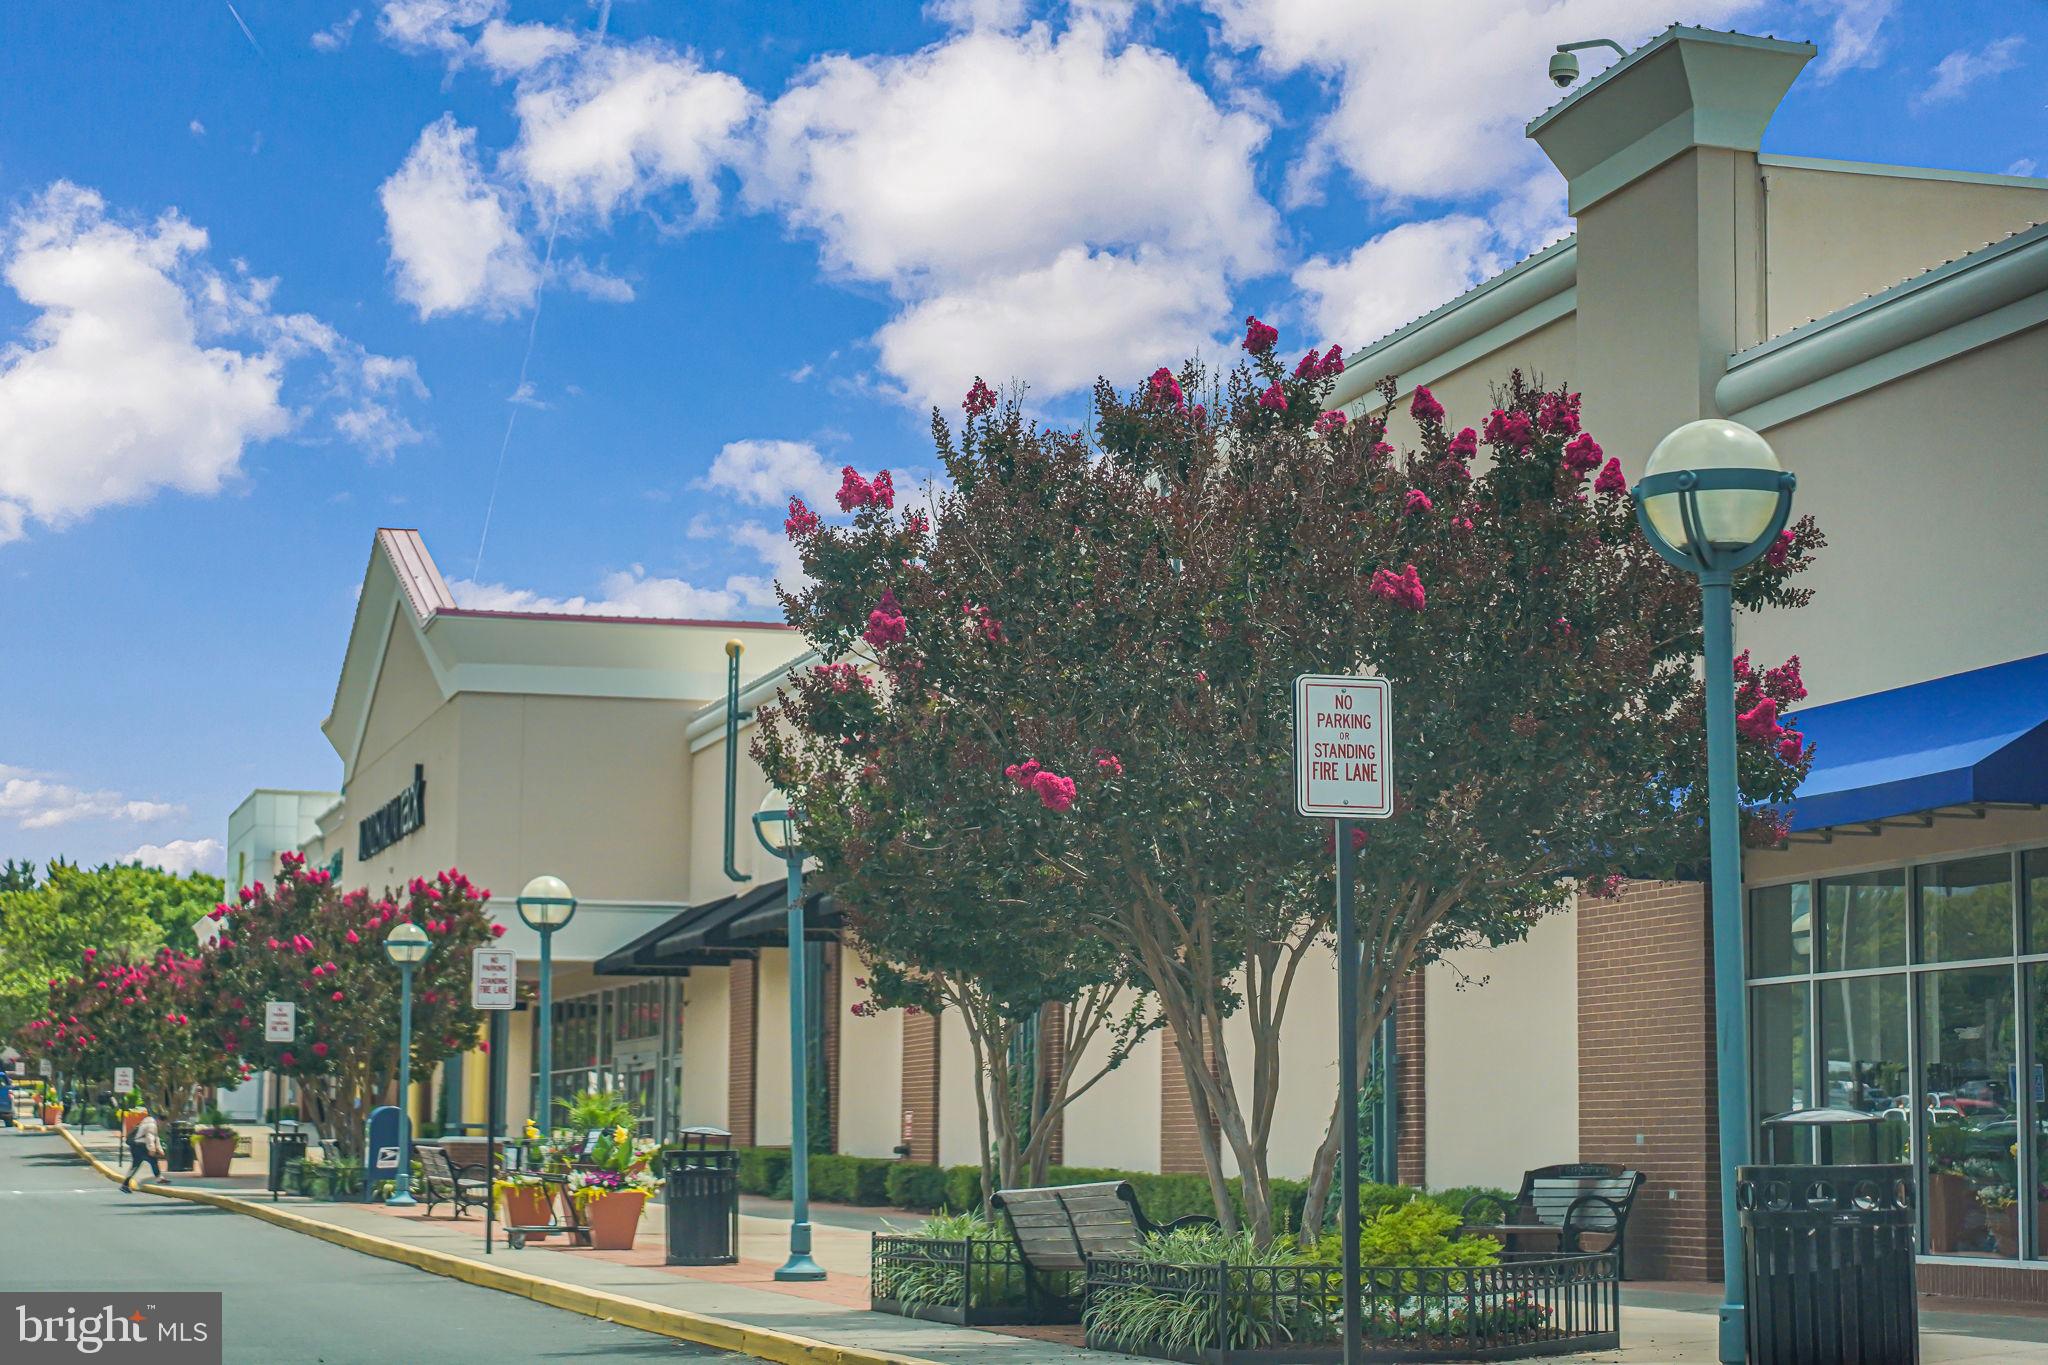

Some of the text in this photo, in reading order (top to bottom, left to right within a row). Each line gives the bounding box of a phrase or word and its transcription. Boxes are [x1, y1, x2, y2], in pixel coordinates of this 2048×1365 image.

[1335, 694, 1353, 710] NO
[1317, 713, 1371, 730] PARKING
[1339, 732, 1350, 740] OR
[1314, 742, 1375, 760] STANDING
[1312, 761, 1378, 782] FIRE LANE
[480, 977, 508, 985] STANDING
[480, 985, 509, 994] FIRE LANE
